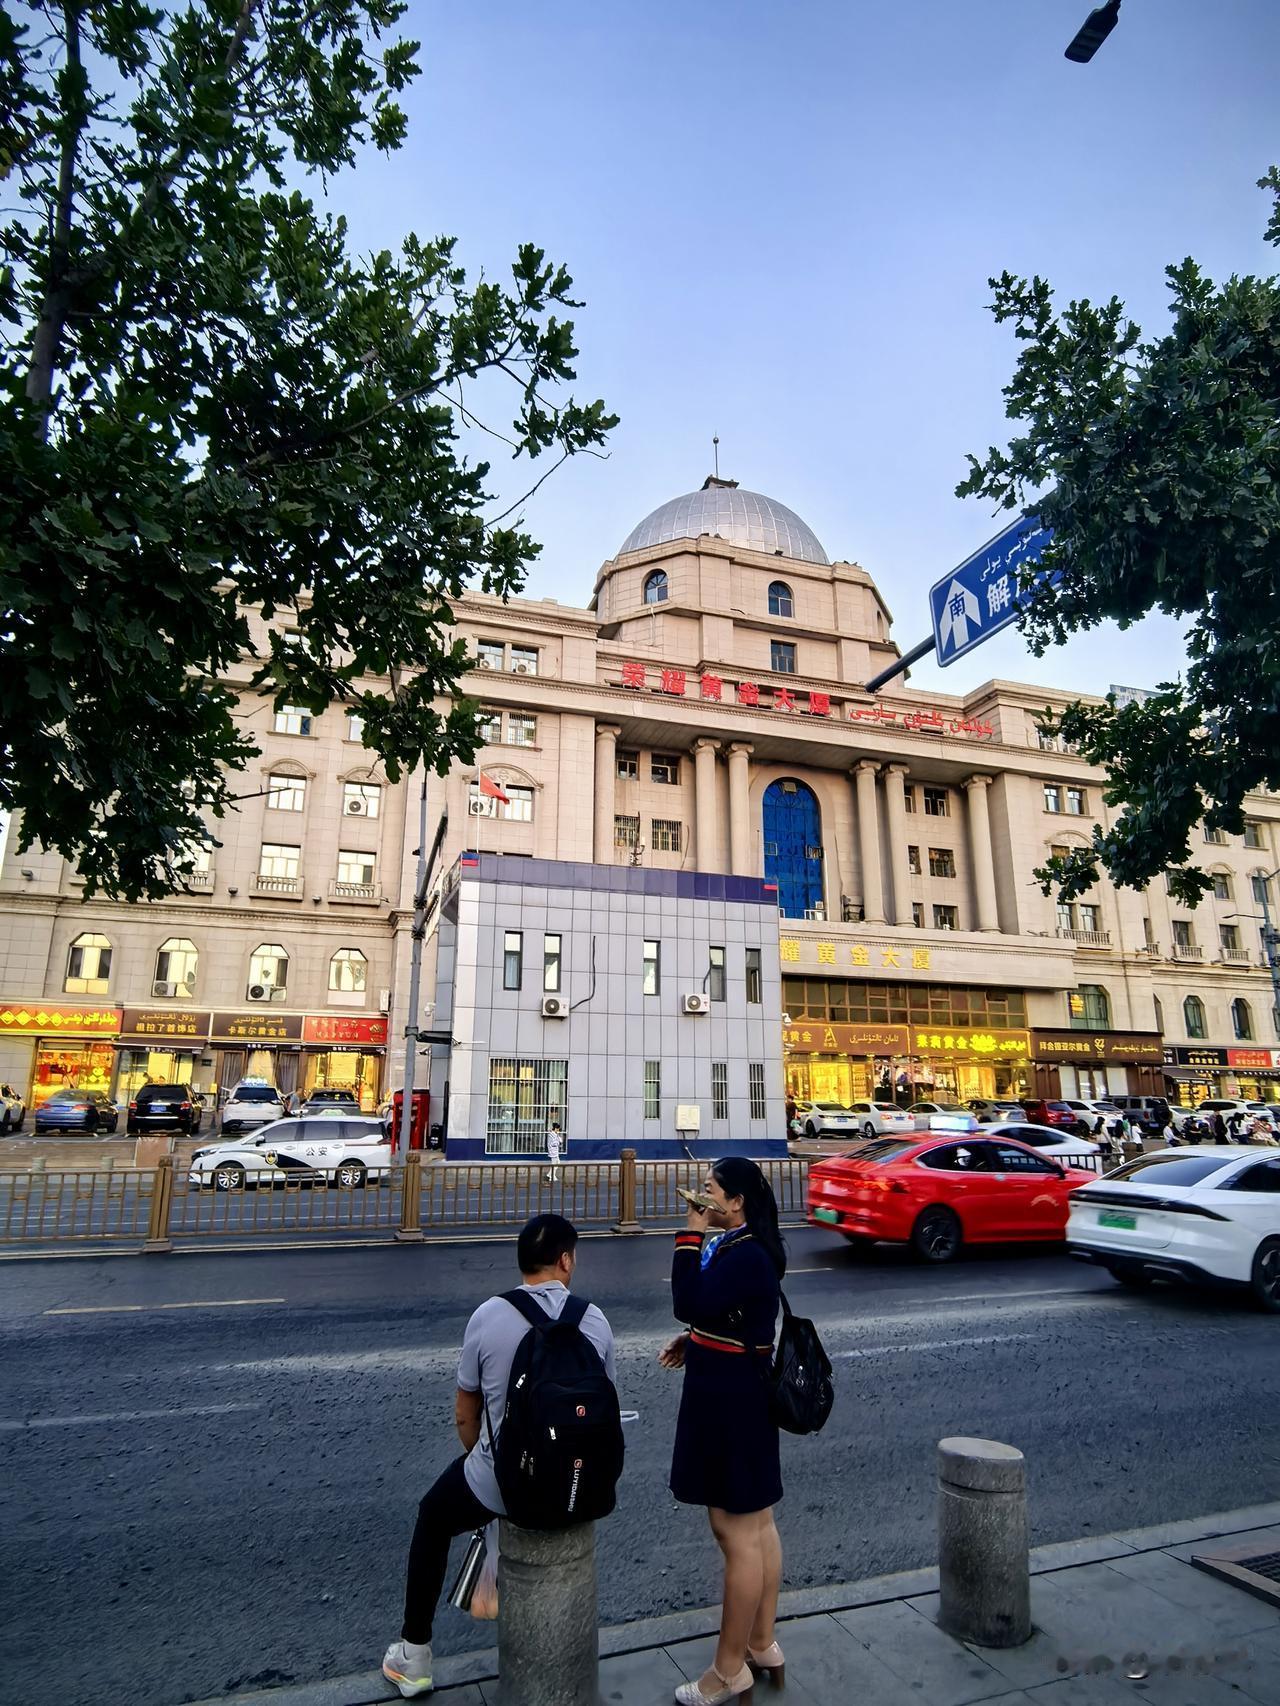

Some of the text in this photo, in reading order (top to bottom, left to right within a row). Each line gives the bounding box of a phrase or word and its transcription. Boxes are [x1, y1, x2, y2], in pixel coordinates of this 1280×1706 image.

[979, 555, 1002, 582] يولى
[948, 590, 966, 622] 南
[622, 662, 831, 715] 荣耀黄金大厦
[305, 1147, 328, 1157] 公安
